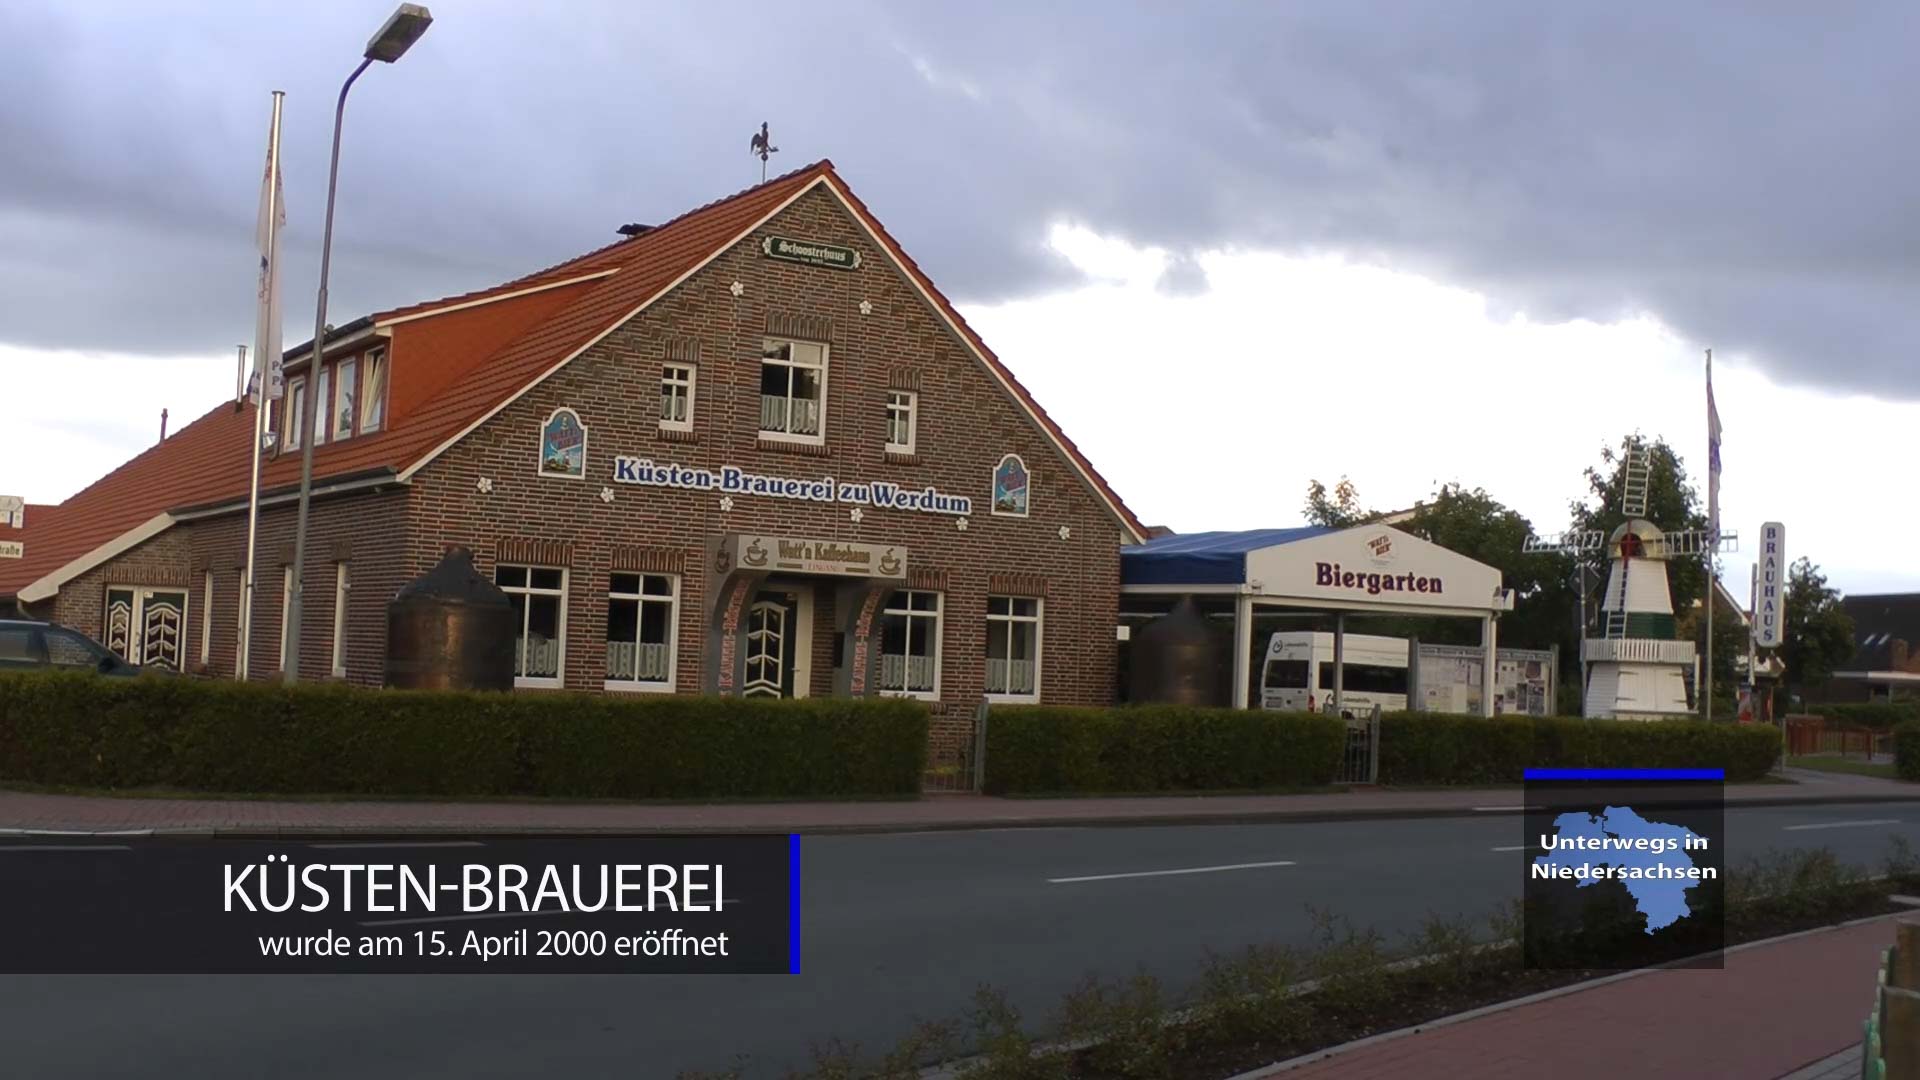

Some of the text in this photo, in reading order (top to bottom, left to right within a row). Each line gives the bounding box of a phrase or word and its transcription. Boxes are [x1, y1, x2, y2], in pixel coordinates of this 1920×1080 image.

[615, 457, 970, 513] Küsten-Brauerei zu Werdum
[1316, 562, 1443, 595] Biergarten
[1763, 527, 1777, 641] BRAUHAUS
